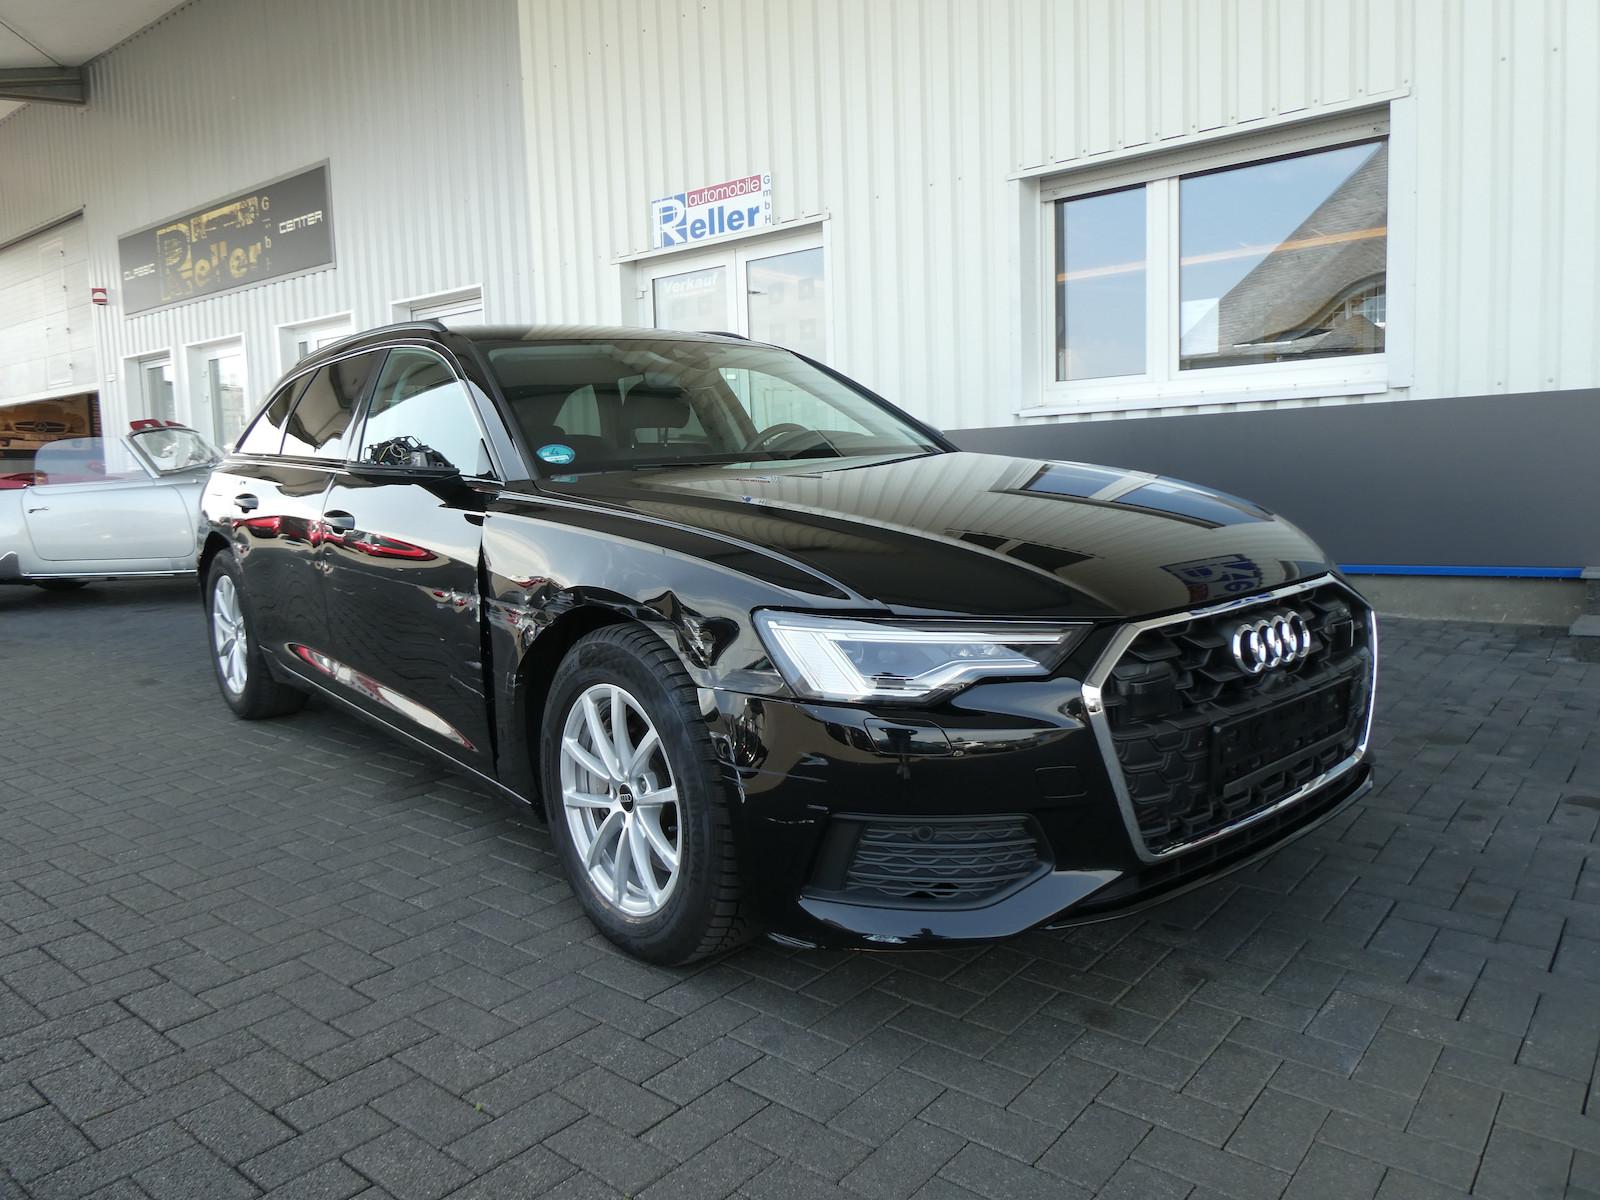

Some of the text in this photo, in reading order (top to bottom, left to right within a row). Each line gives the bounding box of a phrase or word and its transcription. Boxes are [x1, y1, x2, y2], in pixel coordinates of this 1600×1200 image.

[689, 180, 759, 206] automobile
[279, 211, 323, 234] CENTER
[653, 198, 760, 248] Reller
[664, 272, 718, 293] Verkauf
